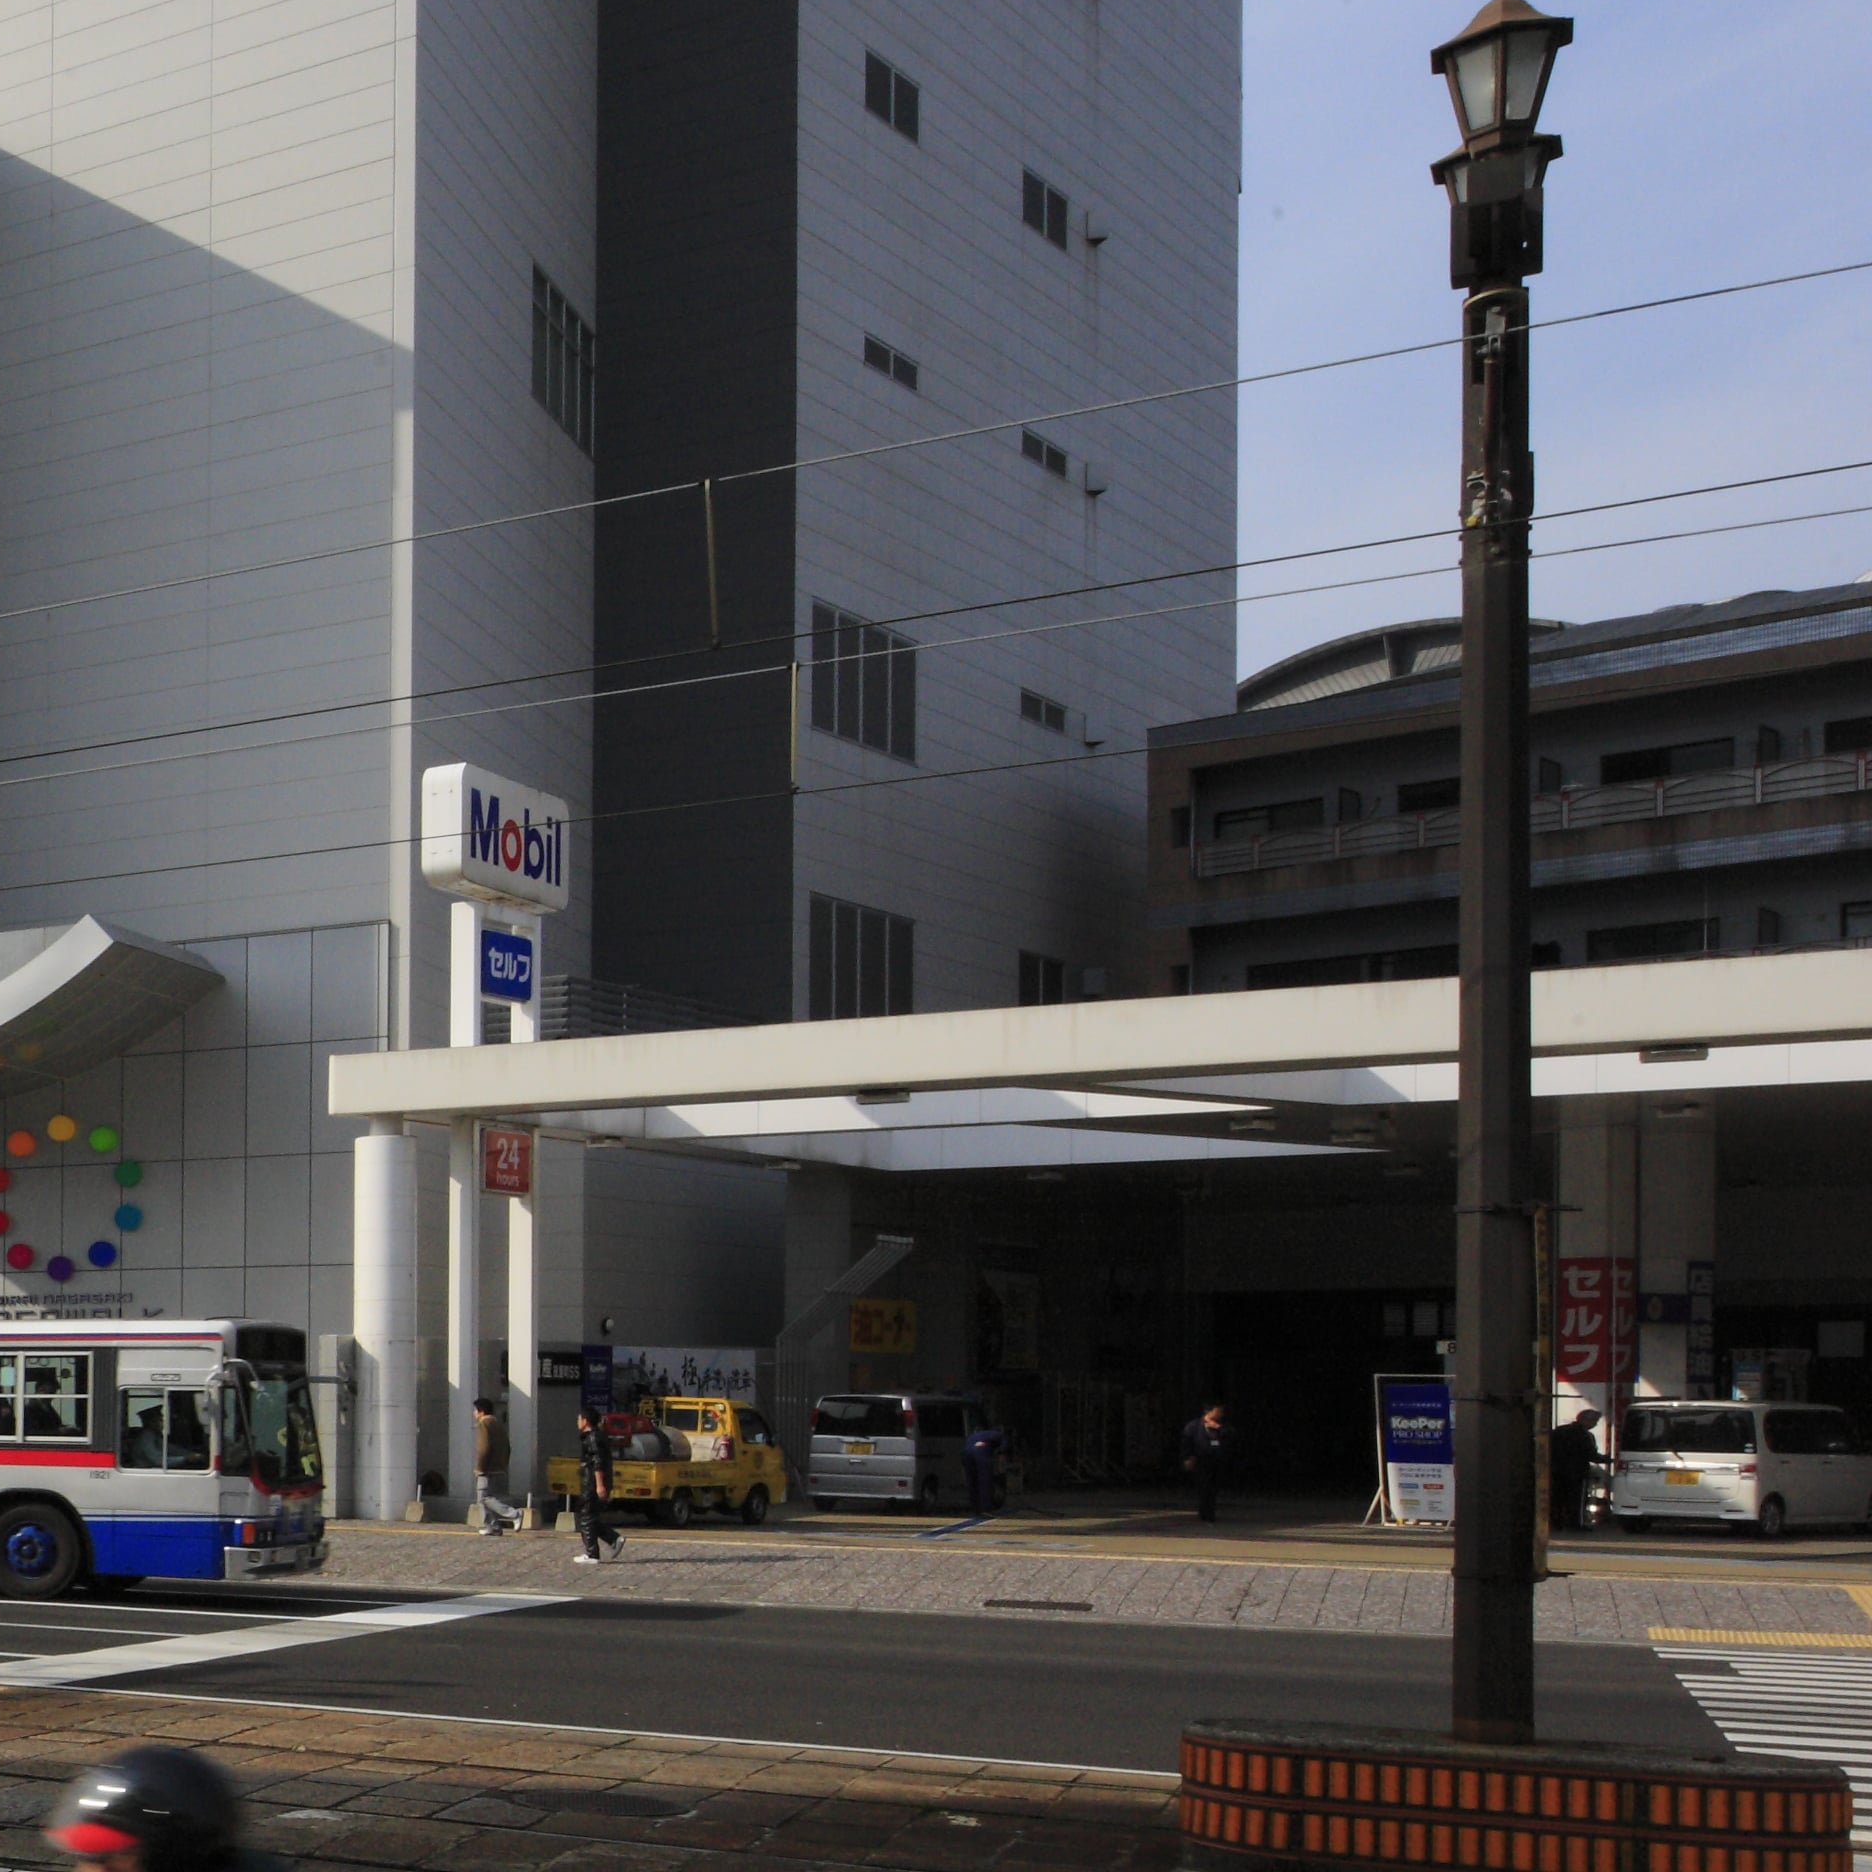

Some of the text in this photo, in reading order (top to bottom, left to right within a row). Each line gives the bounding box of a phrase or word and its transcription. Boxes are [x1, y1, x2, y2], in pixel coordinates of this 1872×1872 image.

[470, 787, 560, 887] Mobil
[488, 947, 531, 982] セルフ
[497, 1138, 520, 1170] 24
[496, 1171, 520, 1187] hours
[1561, 1265, 1603, 1375] セルフ
